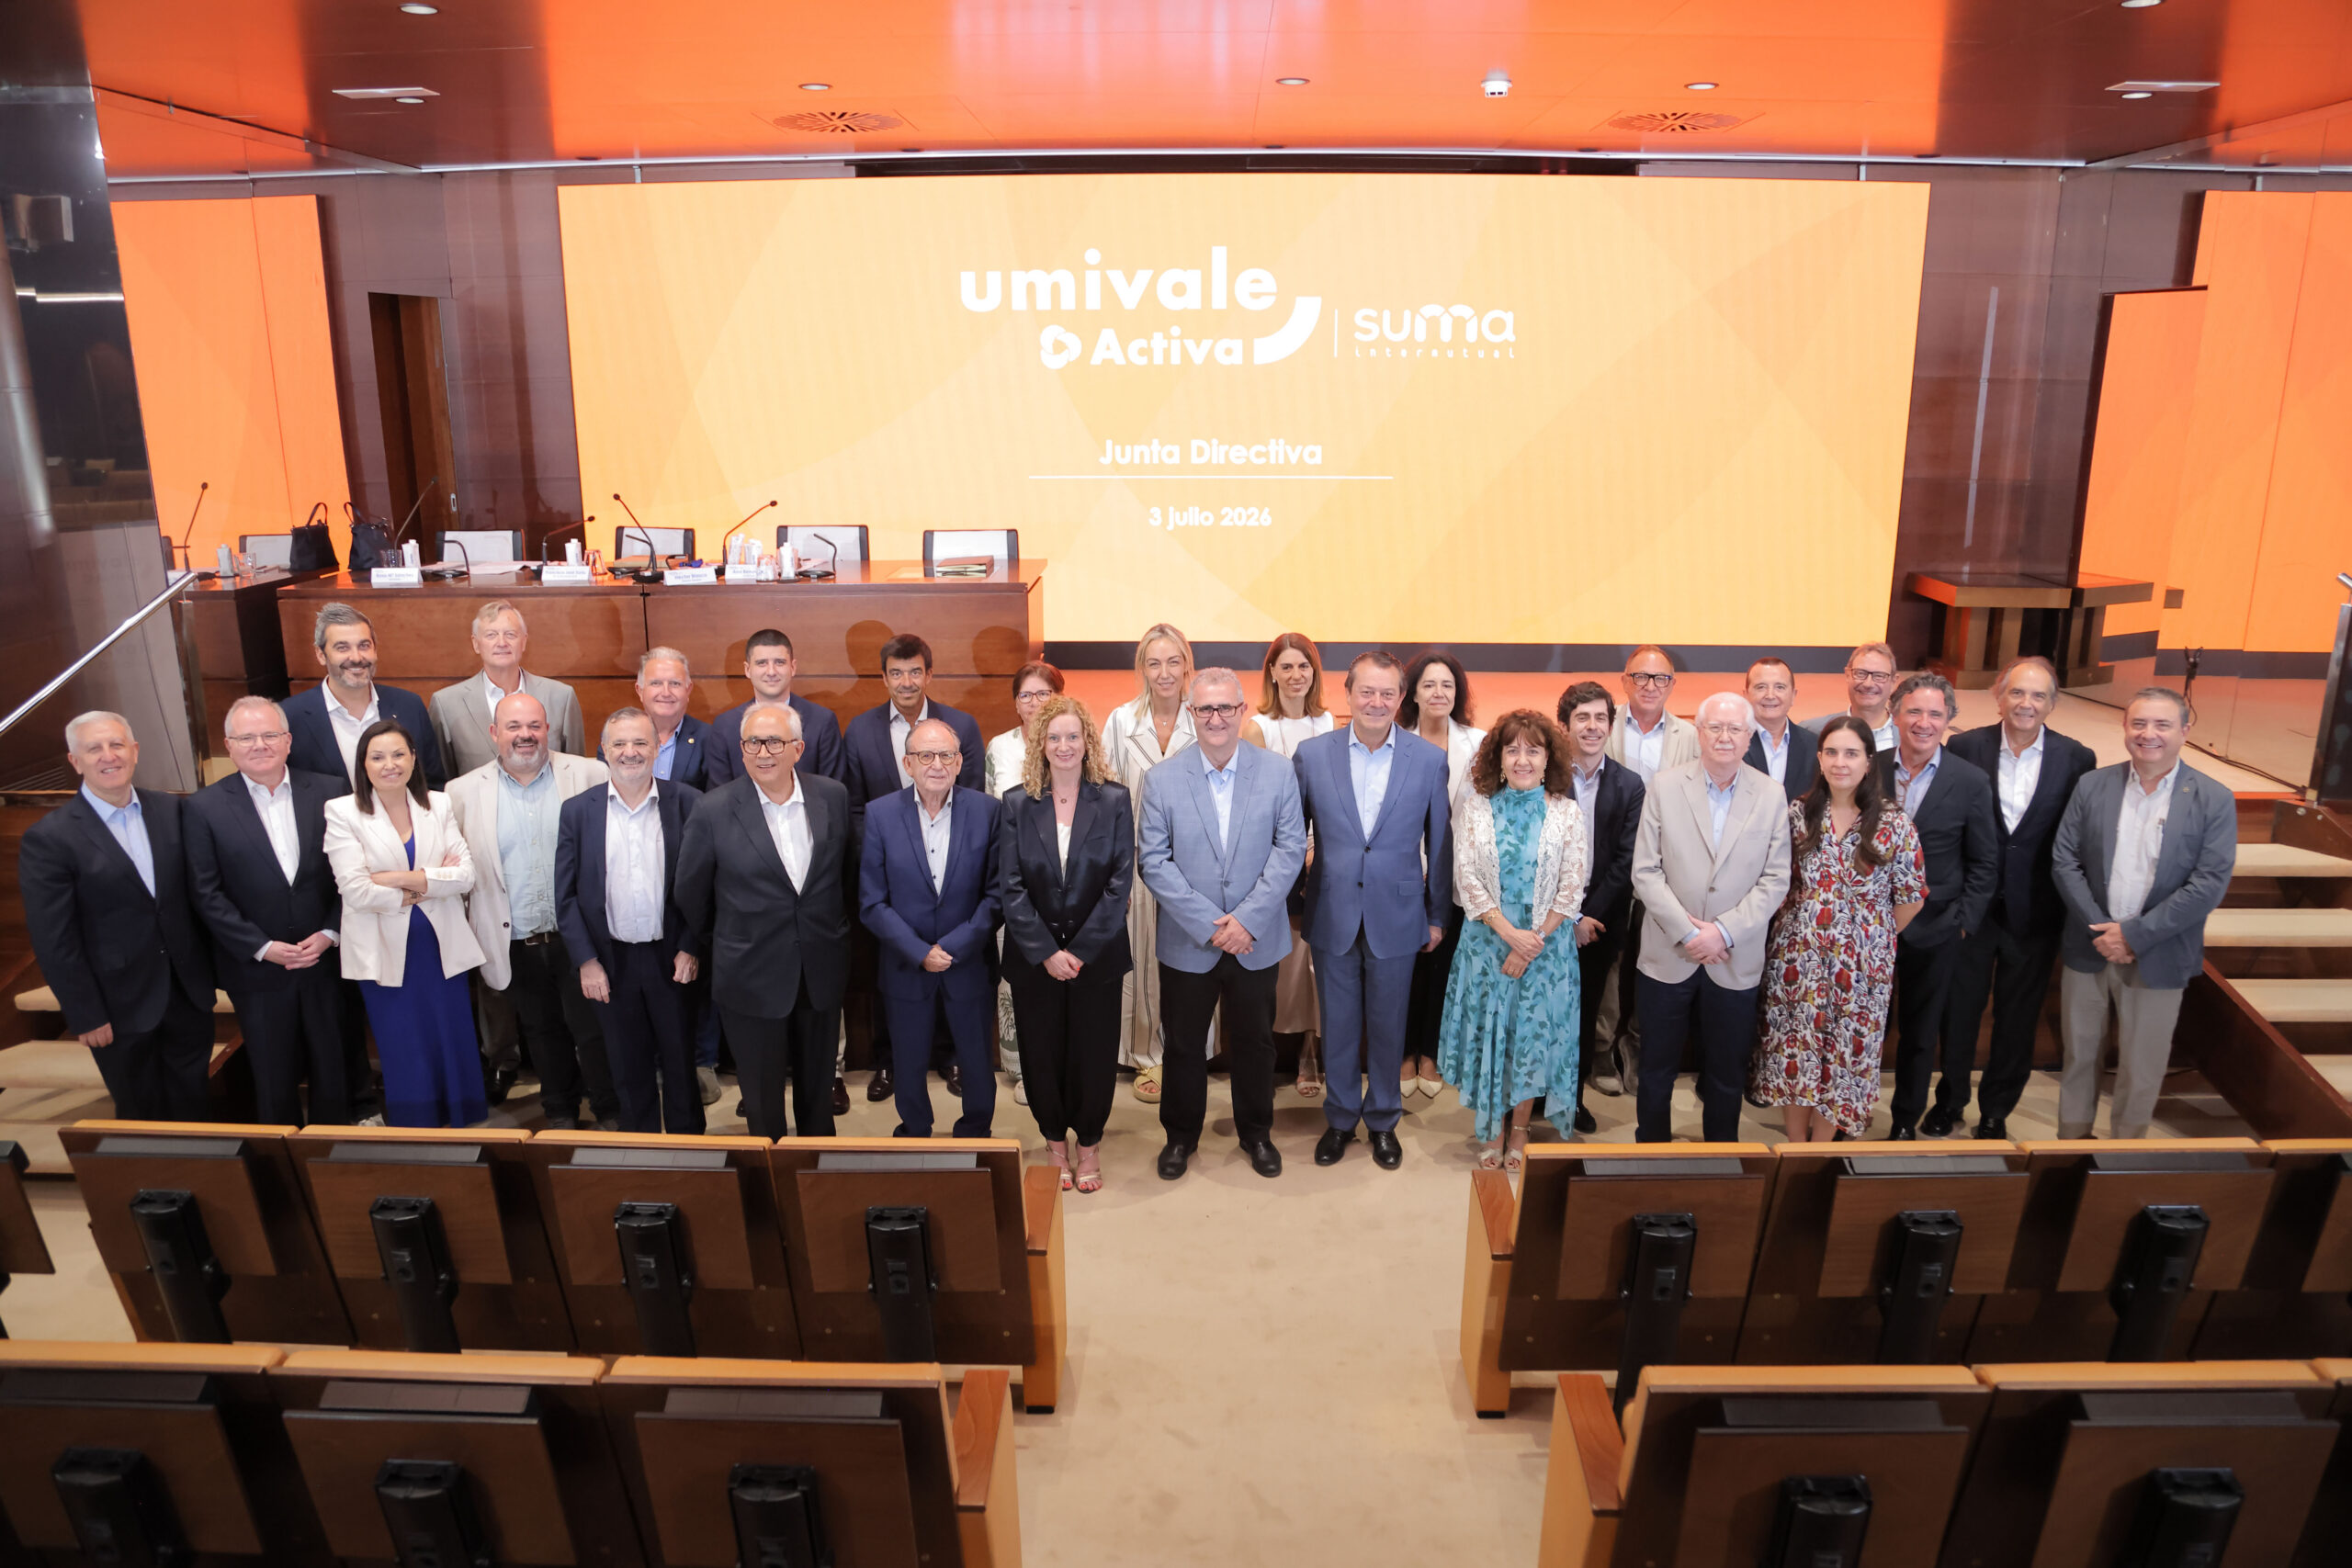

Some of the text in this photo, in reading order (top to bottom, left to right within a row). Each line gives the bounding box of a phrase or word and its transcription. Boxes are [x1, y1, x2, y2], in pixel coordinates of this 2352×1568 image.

[960, 245, 1278, 312] umivale
[1353, 303, 1516, 344] suma
[1090, 325, 1243, 366] Activa
[1099, 438, 1322, 465] Junta Directiva
[1148, 506, 1272, 531] 3 julio 2026
